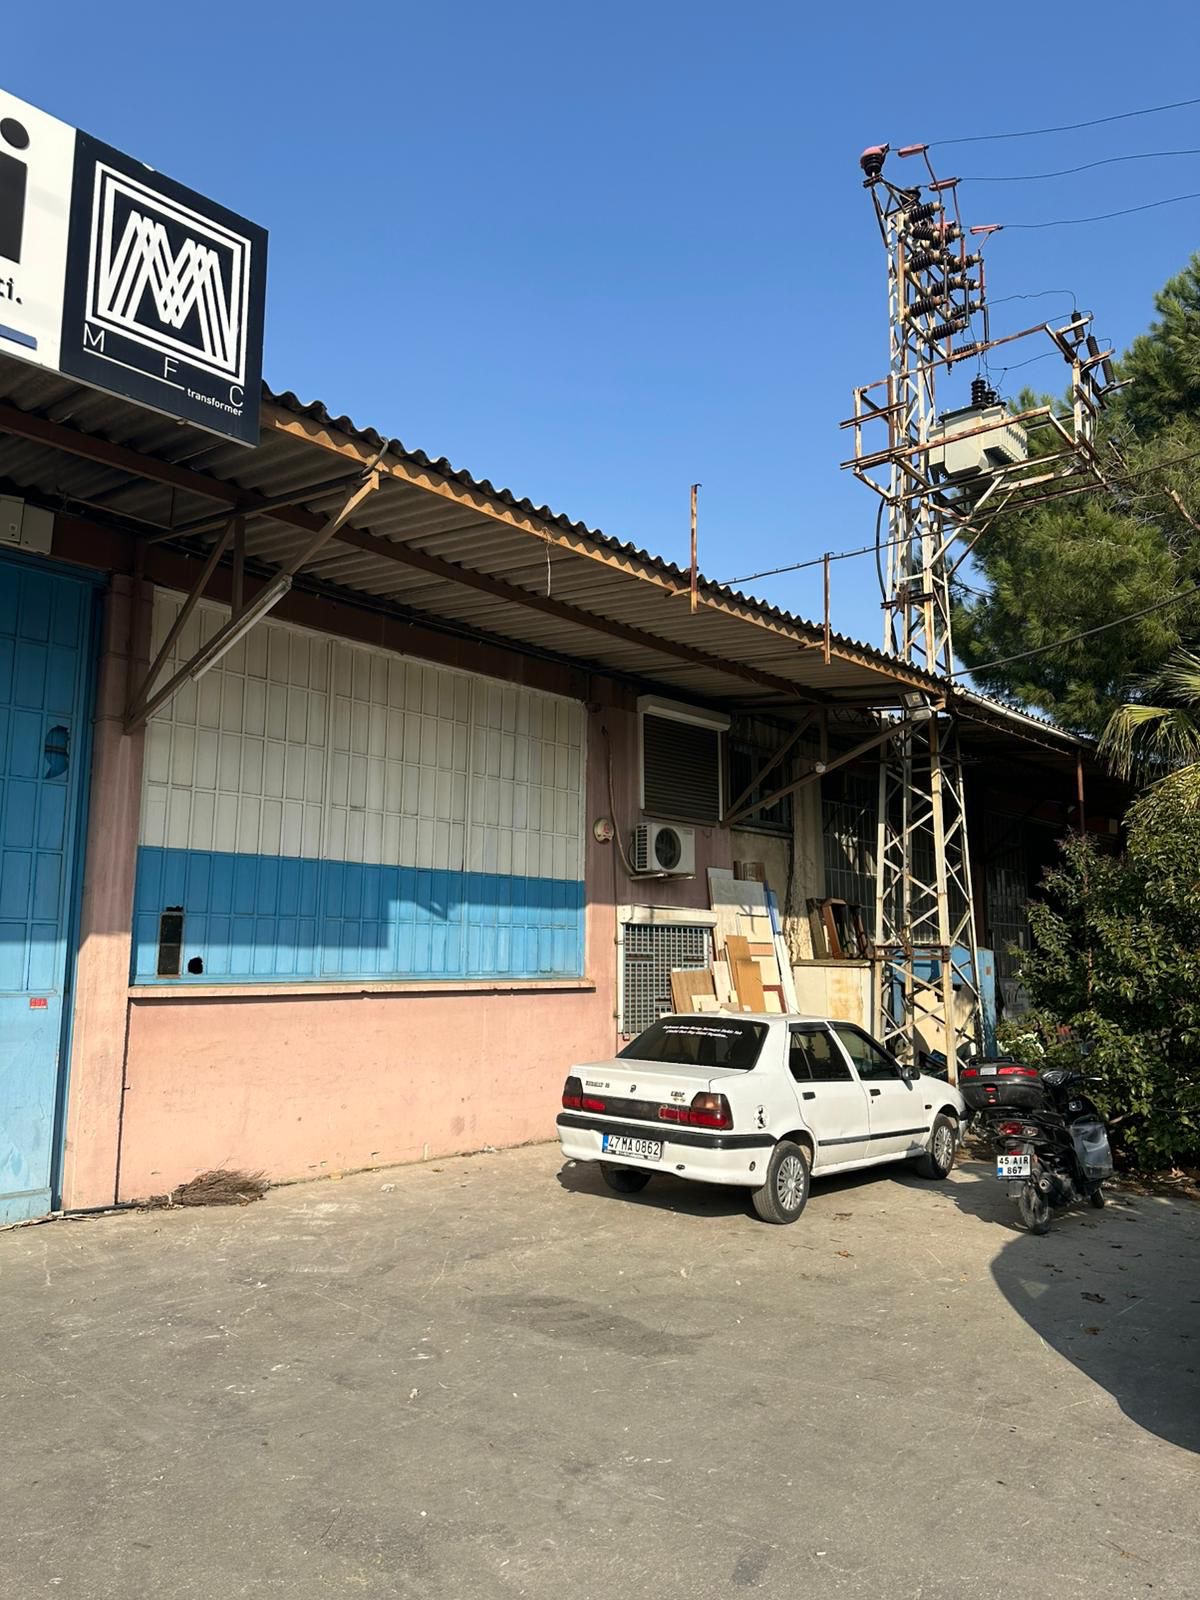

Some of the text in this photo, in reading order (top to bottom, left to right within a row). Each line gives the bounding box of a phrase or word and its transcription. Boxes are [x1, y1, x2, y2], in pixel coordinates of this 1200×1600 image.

[187, 388, 243, 417] transformer
[608, 1135, 621, 1149] 47
[621, 1137, 633, 1151] MA
[635, 1139, 660, 1155] 0862
[999, 1156, 1028, 1164] 45 AIR
[1007, 1166, 1022, 1174] 867
